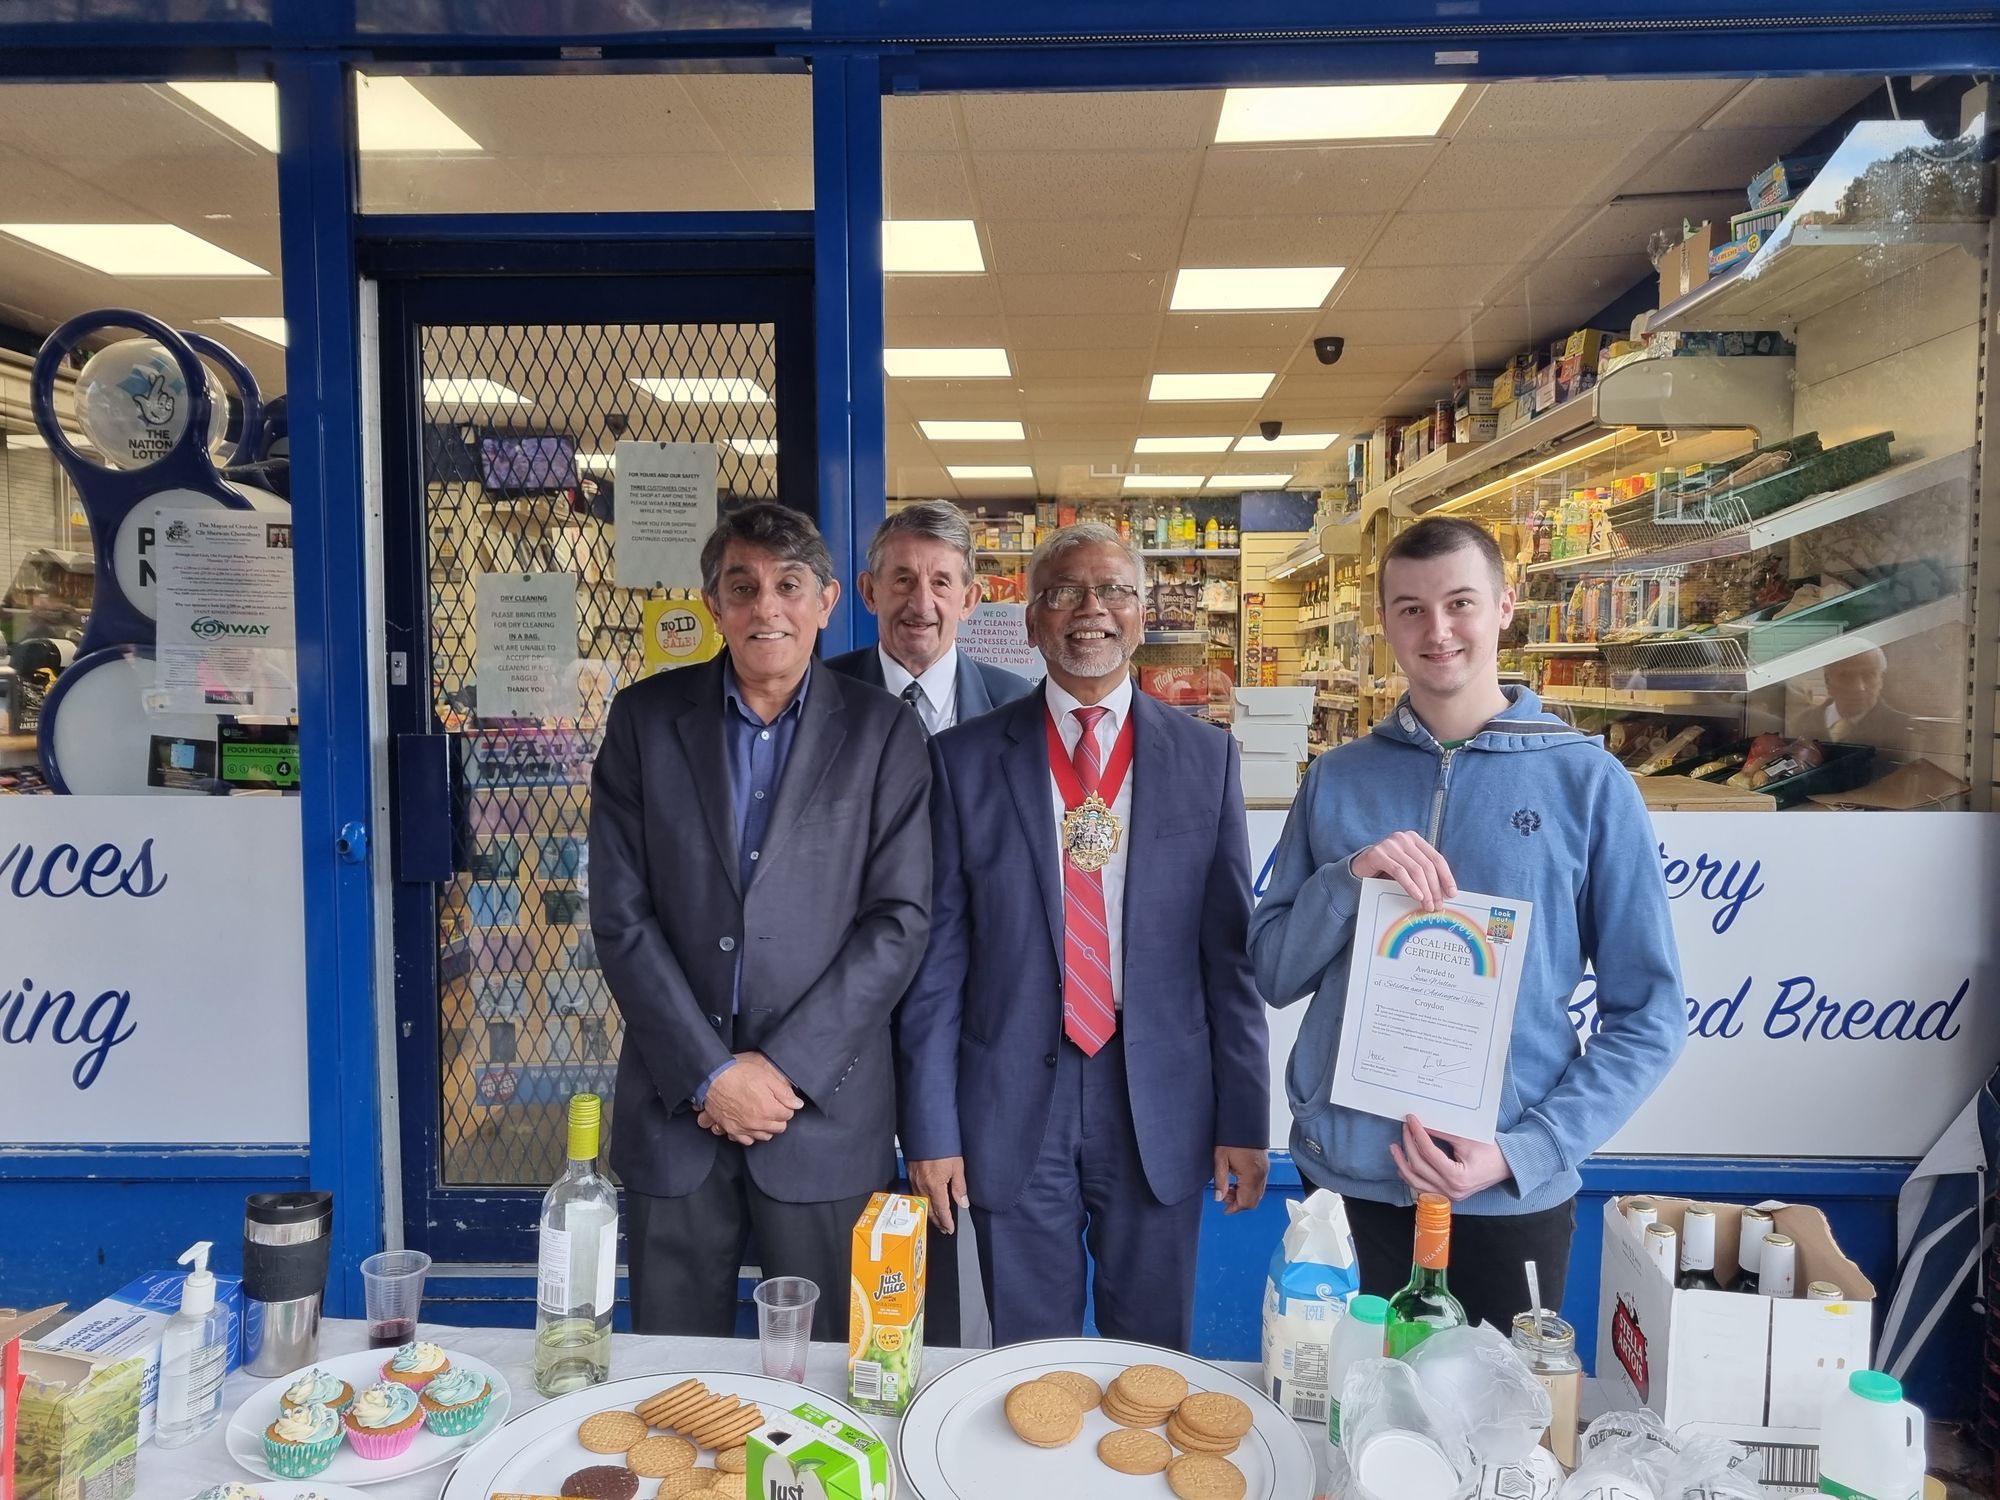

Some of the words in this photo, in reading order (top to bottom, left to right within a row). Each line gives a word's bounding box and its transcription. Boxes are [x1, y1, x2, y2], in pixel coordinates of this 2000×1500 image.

[146, 429, 170, 439] THE
[190, 621, 271, 636] CONWAY
[660, 621, 676, 632] NO
[674, 616, 696, 633] ID
[971, 628, 1018, 636] ALTERATIONS
[663, 636, 697, 649] SALE!
[991, 647, 1031, 655] CLEANING
[279, 763, 288, 774] 4
[1494, 908, 1511, 918] Look
[1406, 934, 1441, 950] LOCAL
[1443, 941, 1473, 955] HERO
[1404, 946, 1471, 967] CERTIFICATE
[1415, 965, 1447, 978] Awarded
[1374, 979, 1381, 987] of
[1414, 998, 1445, 1012] Croydon
[1763, 975, 1971, 1043] Bread
[91, 1315, 123, 1335] Mask
[1619, 1312, 1643, 1363] STELLA
[1617, 1332, 1643, 1382] ARTOIS
[770, 1480, 804, 1500] Just
